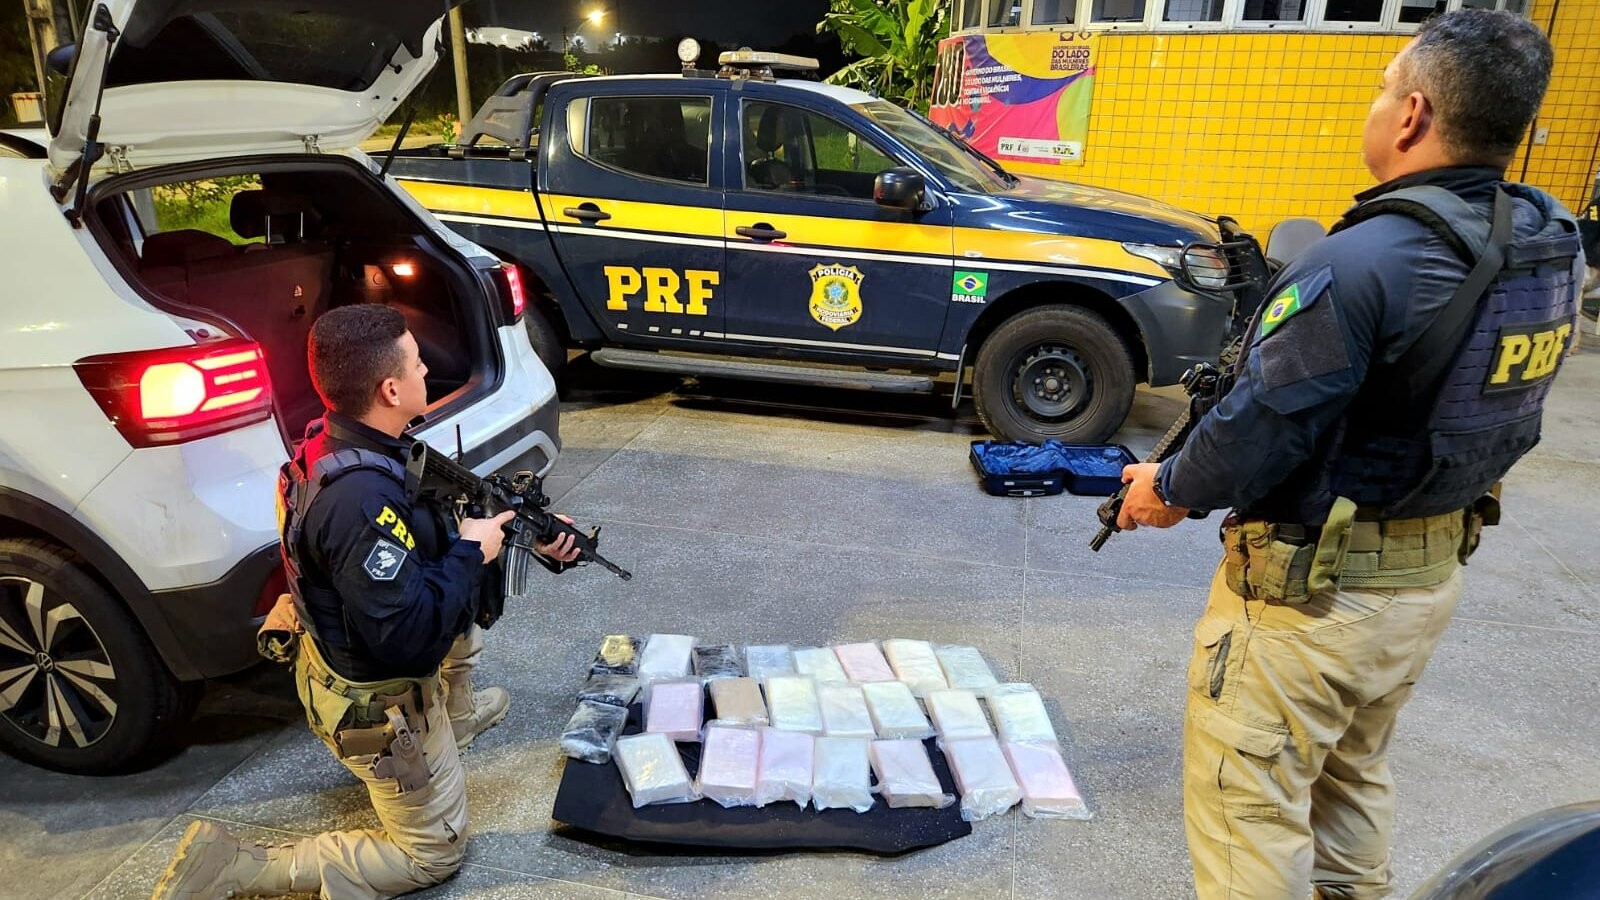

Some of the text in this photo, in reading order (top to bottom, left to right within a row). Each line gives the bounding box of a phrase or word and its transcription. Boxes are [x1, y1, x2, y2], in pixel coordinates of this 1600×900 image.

[1052, 50, 1090, 58] DO LADO
[1000, 143, 1014, 151] PRF
[603, 265, 720, 315] PRF
[952, 294, 987, 304] BRASIL
[1490, 323, 1572, 384] PRF
